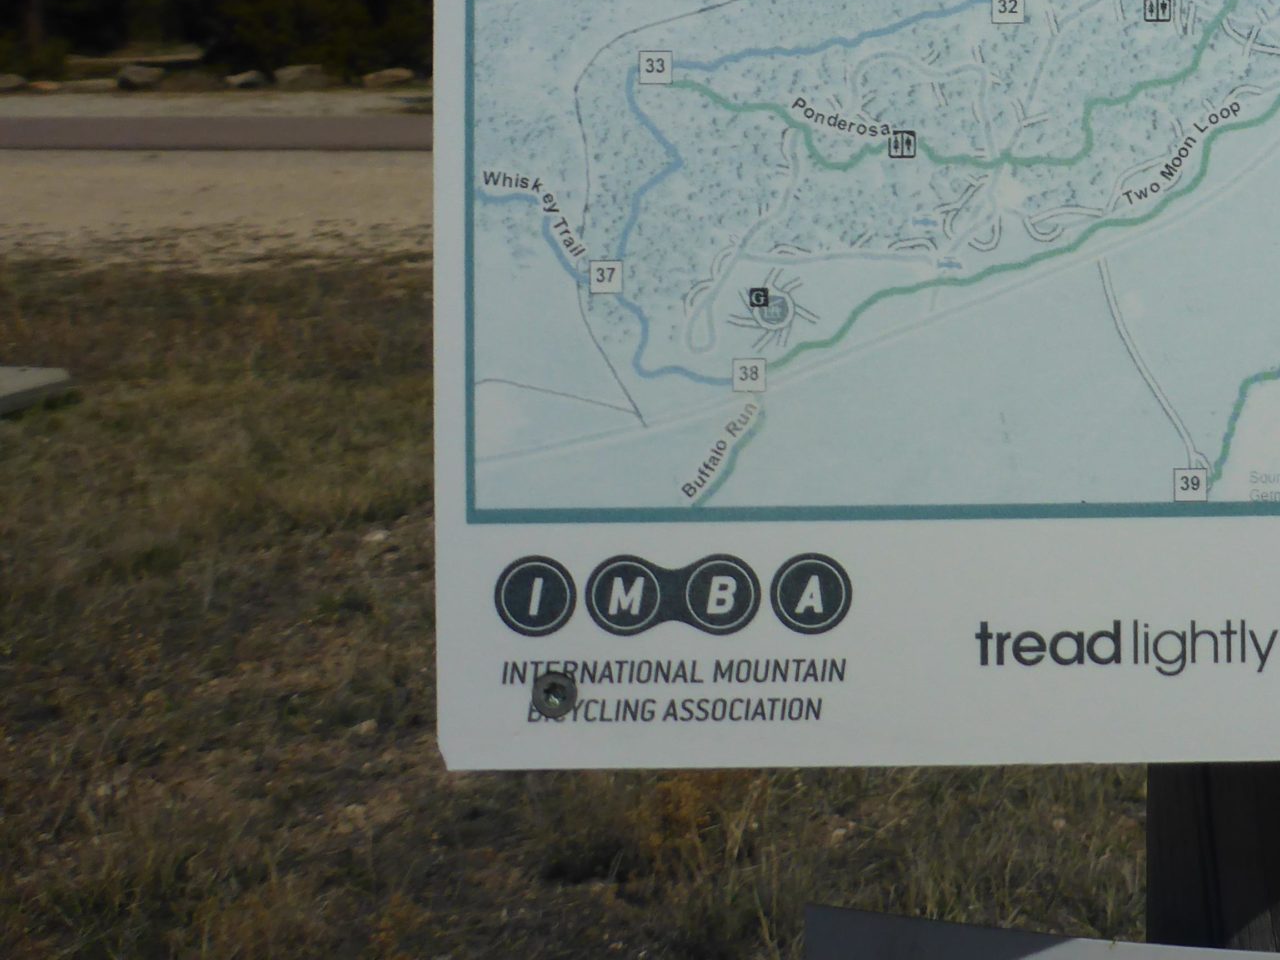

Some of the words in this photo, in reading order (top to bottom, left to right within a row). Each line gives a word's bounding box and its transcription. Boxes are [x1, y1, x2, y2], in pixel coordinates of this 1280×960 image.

[998, 0, 1018, 14] 32
[645, 58, 665, 74] 33
[791, 96, 891, 138] Ponderosa
[1122, 181, 1161, 205] Two
[1160, 136, 1197, 182] Moon
[1193, 100, 1241, 134] Loop
[483, 170, 560, 215] Whiskey
[553, 216, 587, 259] Trail
[596, 268, 616, 283] 37
[739, 366, 759, 381] 38
[682, 439, 727, 499] Buffalo
[725, 403, 757, 438] Run
[1180, 476, 1200, 491] 39
[975, 619, 1121, 666] tread
[713, 658, 846, 683] MOUNTAIN
[662, 696, 823, 722] ASSOCIATION
